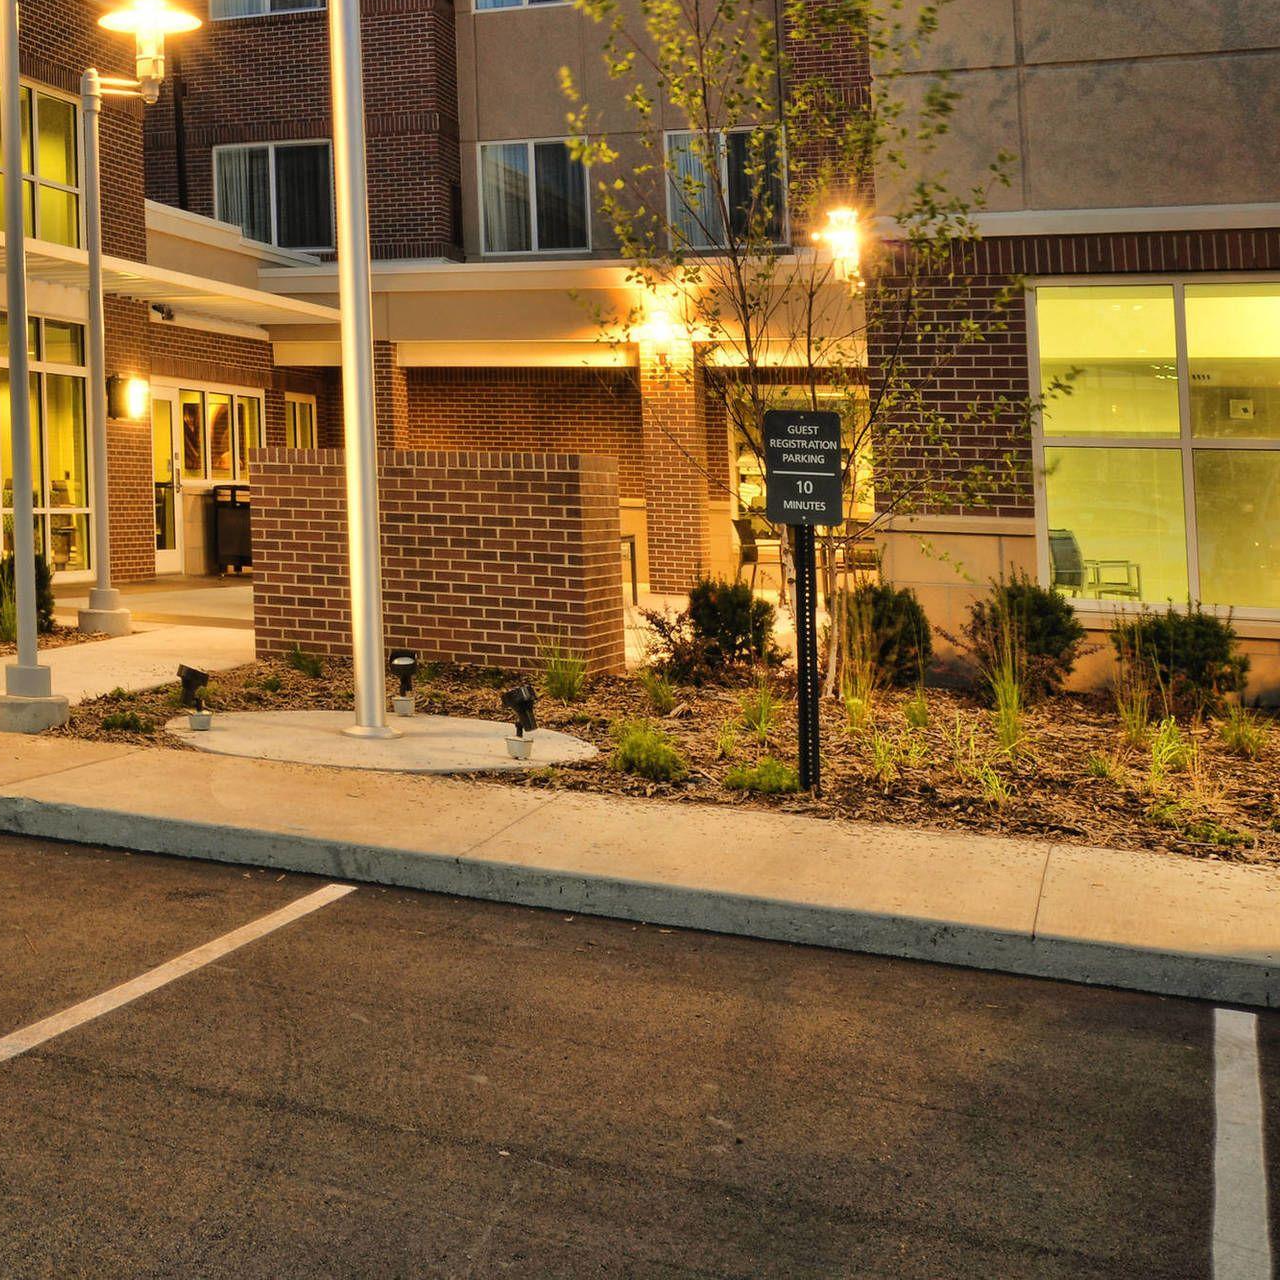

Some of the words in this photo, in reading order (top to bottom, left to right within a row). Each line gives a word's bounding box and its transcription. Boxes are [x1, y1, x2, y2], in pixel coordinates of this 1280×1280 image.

[787, 425, 819, 435] GUEST
[769, 438, 838, 451] REGISTRATION
[782, 453, 825, 464] PARKING
[796, 480, 814, 494] 10
[783, 499, 826, 511] MINUTES
